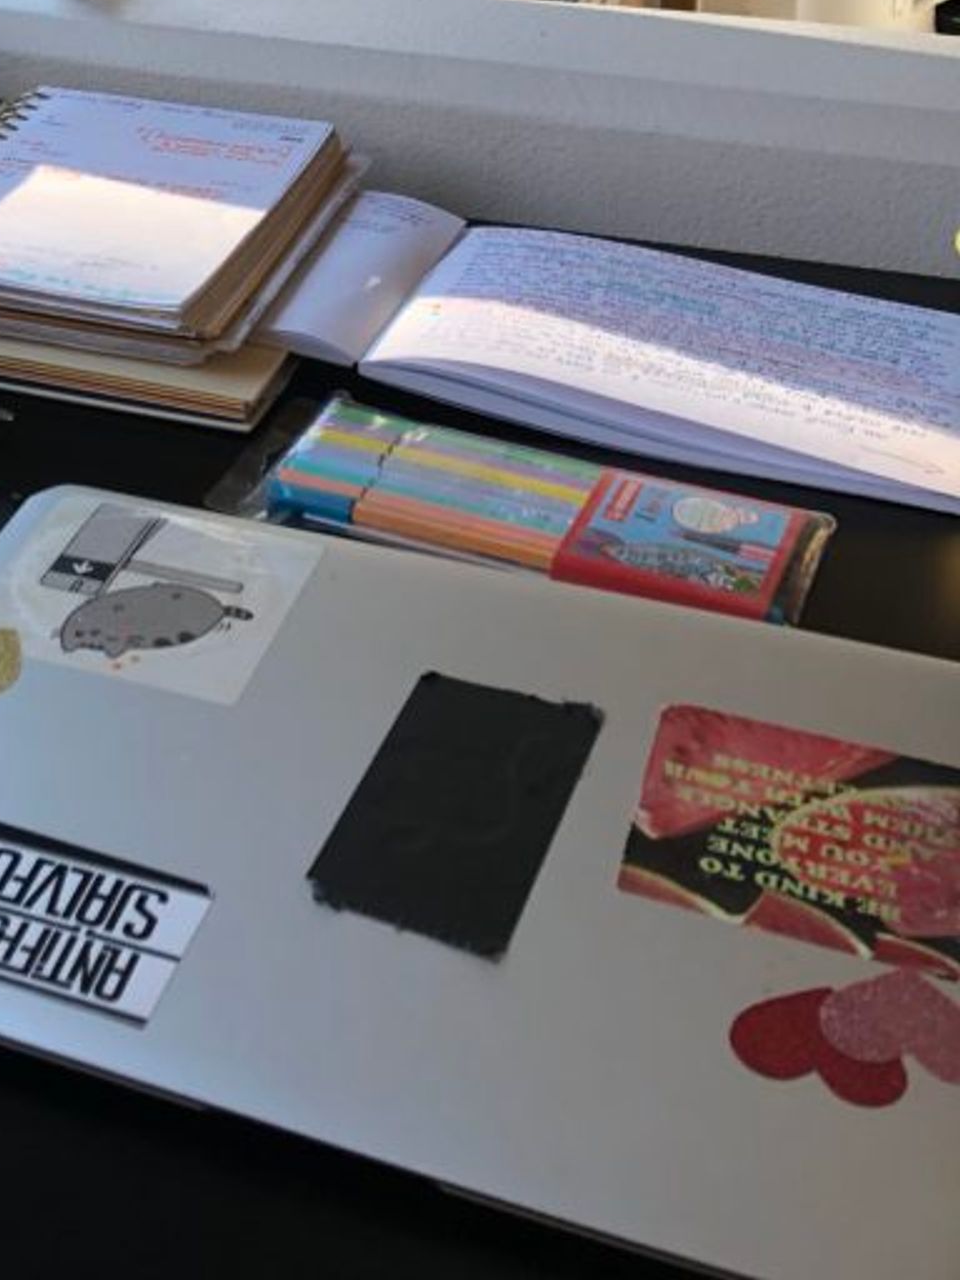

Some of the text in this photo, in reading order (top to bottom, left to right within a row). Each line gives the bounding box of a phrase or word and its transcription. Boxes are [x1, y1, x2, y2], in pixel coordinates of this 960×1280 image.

[706, 834, 899, 897] EVERYONE
[715, 818, 810, 853] MEET
[698, 856, 901, 923] BE KIND TO
